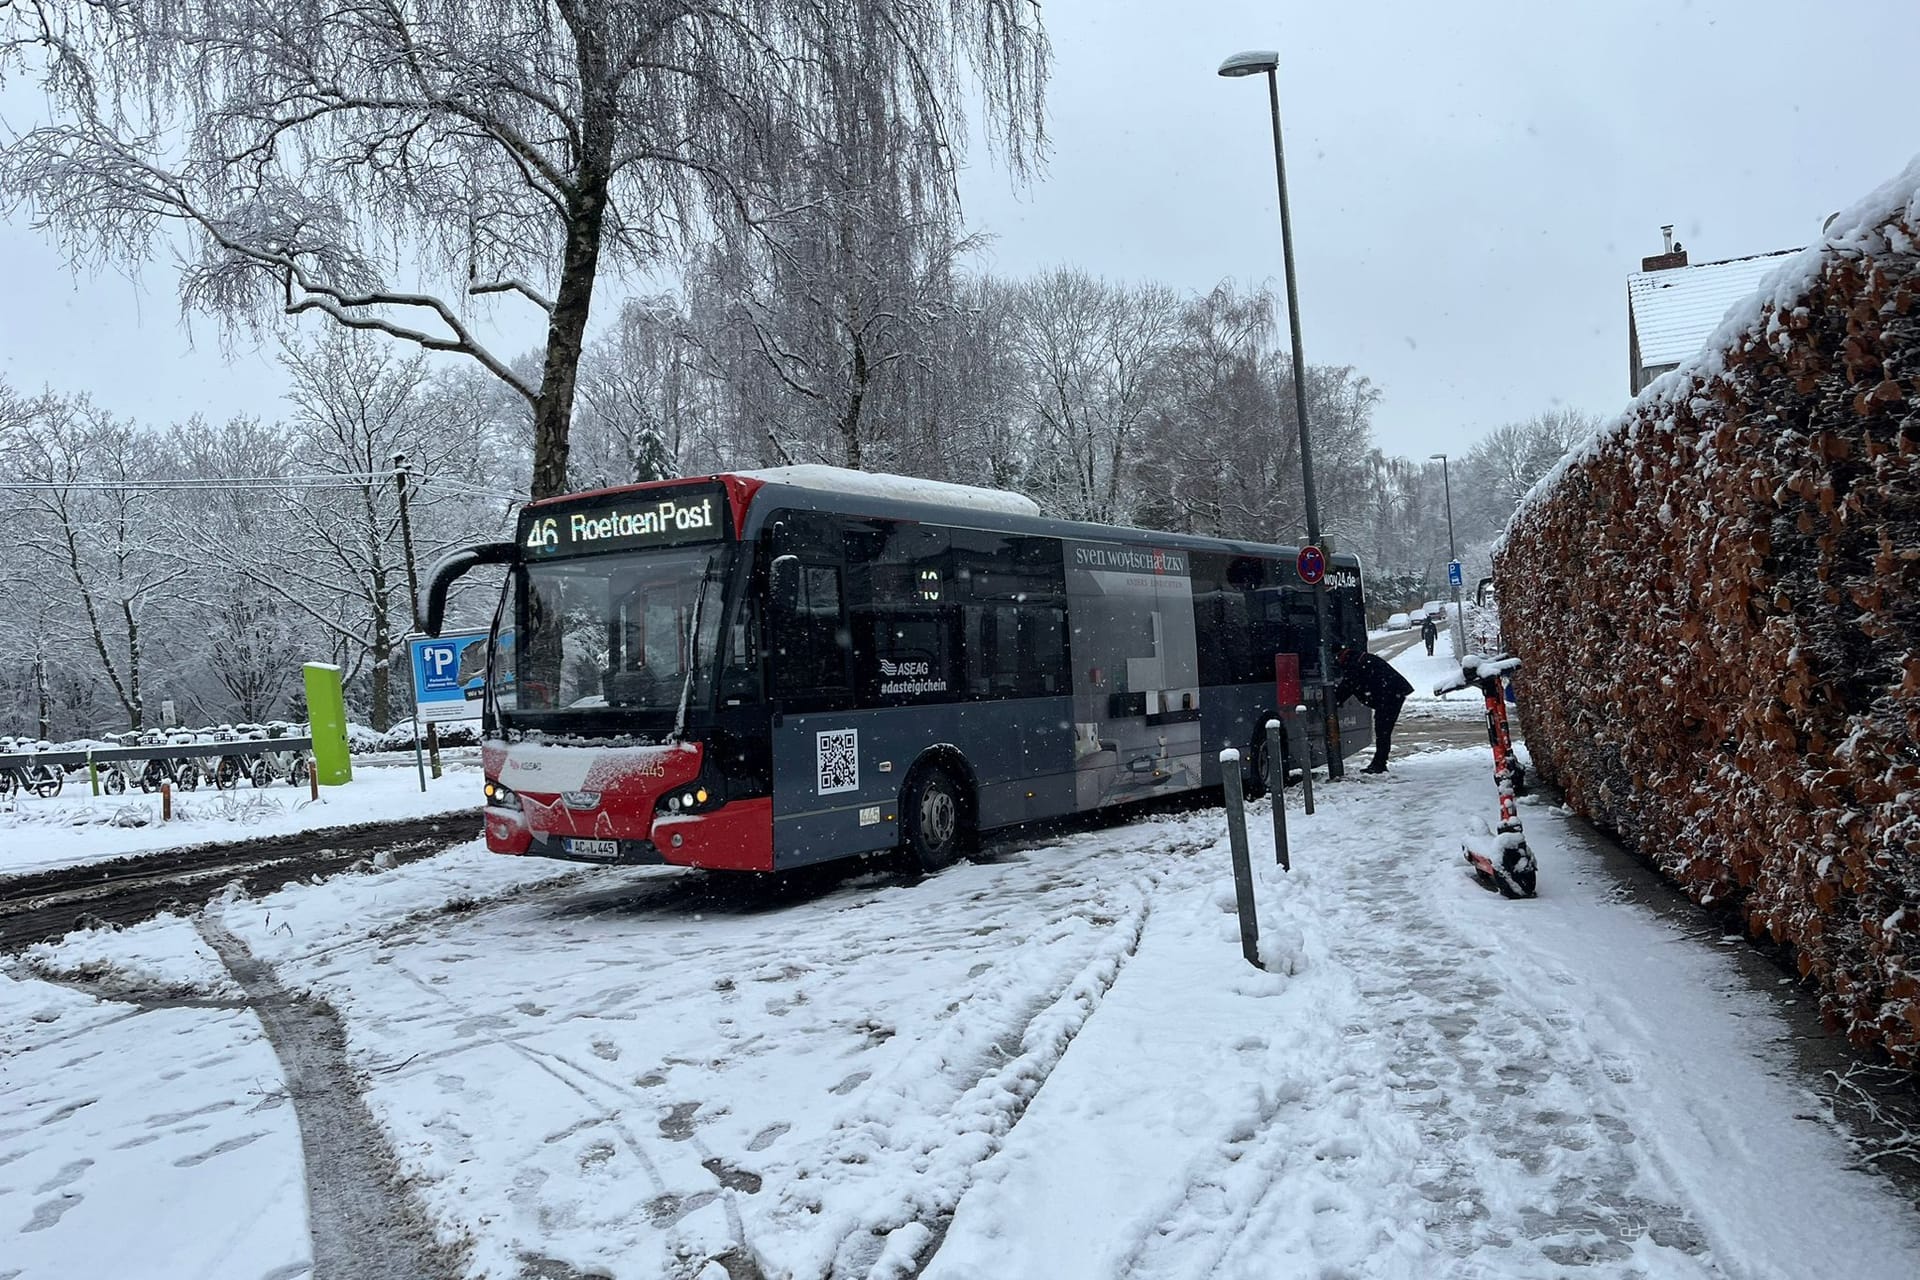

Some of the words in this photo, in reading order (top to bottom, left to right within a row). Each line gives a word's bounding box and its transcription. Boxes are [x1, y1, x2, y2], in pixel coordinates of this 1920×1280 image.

[1076, 547, 1106, 566] sven
[434, 648, 453, 675] P
[898, 662, 929, 676] ASEAG
[641, 760, 665, 778] 445
